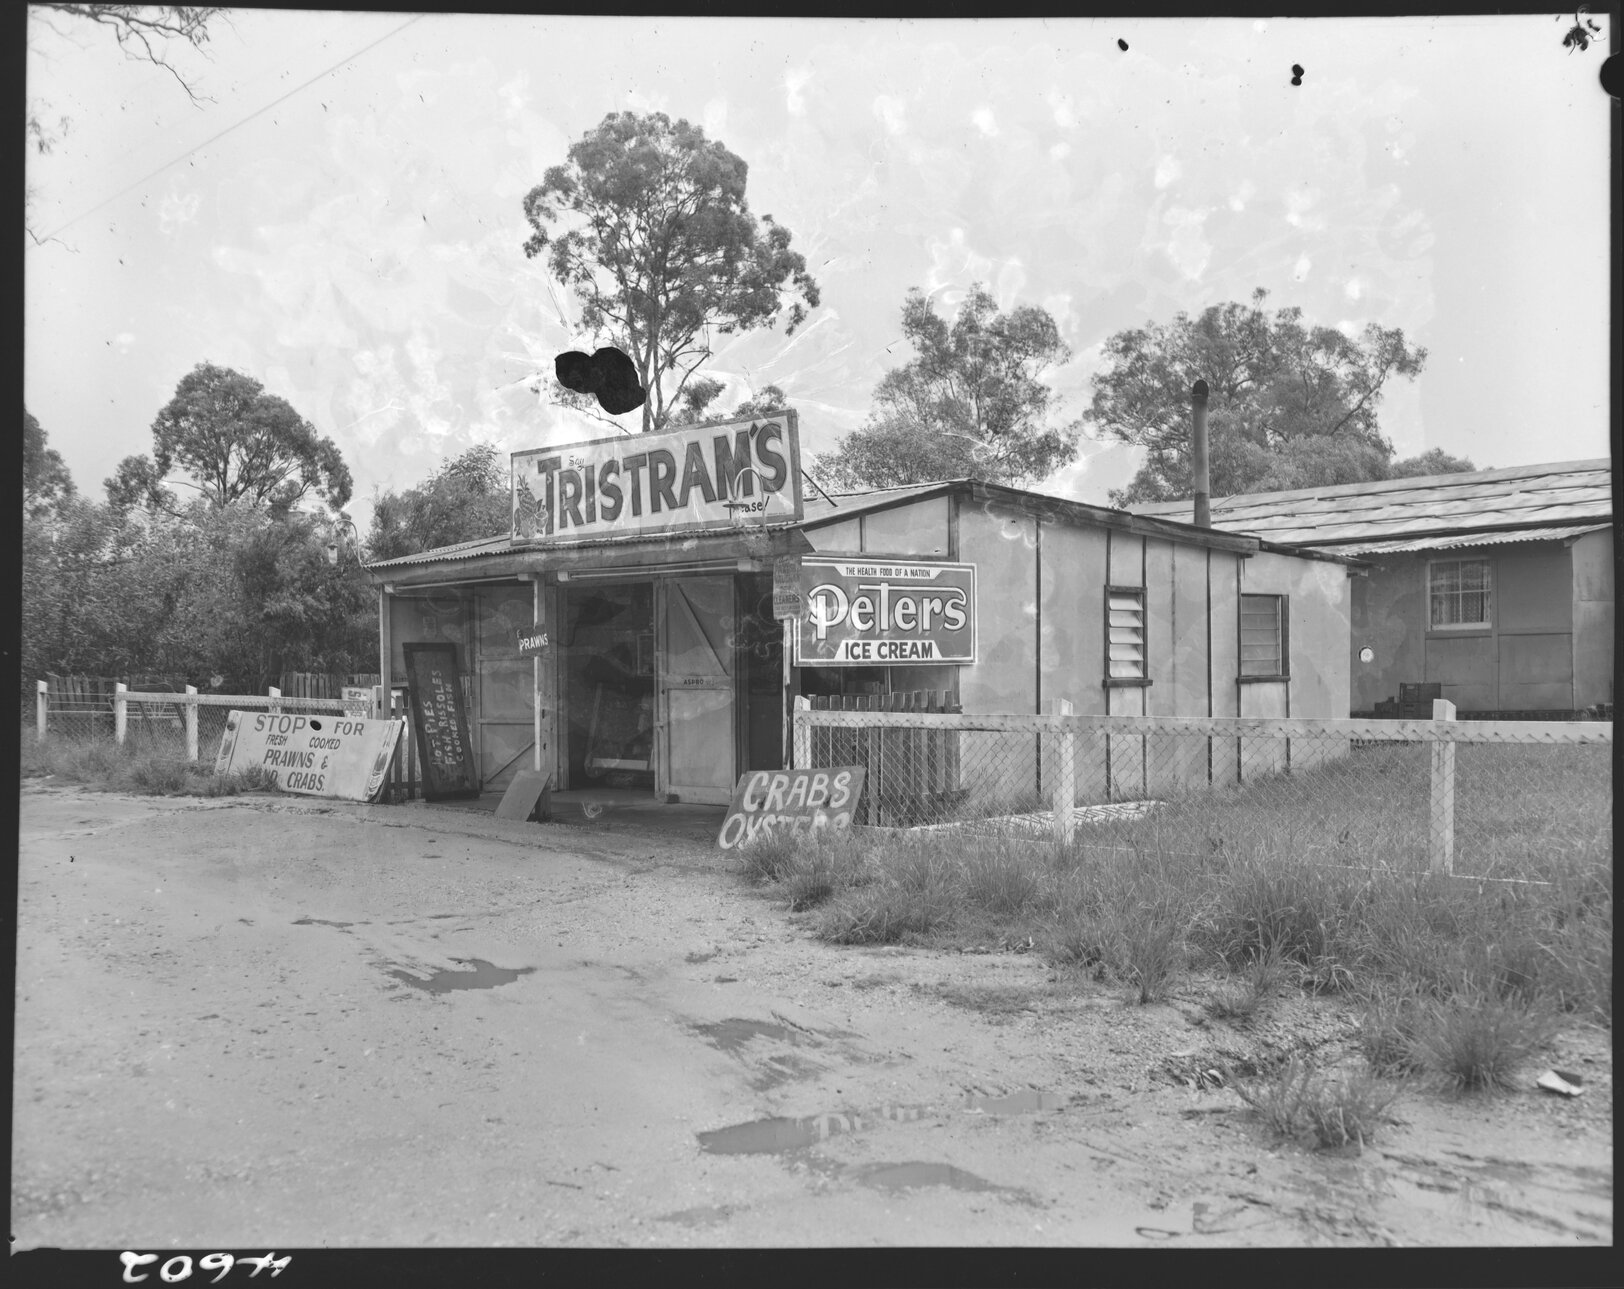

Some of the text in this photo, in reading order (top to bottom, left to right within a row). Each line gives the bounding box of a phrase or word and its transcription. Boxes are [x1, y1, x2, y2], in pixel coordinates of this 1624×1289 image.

[569, 456, 585, 471] Say
[537, 422, 787, 535] TRISTRAM'S
[846, 567, 931, 578] THE HEALTH FOOD OF A NATION
[808, 582, 967, 640] Peters
[519, 633, 549, 652] PRAWNS
[845, 642, 933, 660] ICE CREAM
[432, 670, 449, 728] RISSOLES
[254, 714, 365, 736] STOP FOR
[423, 700, 438, 734] PIES
[265, 734, 341, 750] FRESH COOKED
[263, 749, 328, 770] PRAWNS &
[287, 771, 325, 792] CRABS.
[743, 771, 851, 812] CRABS
